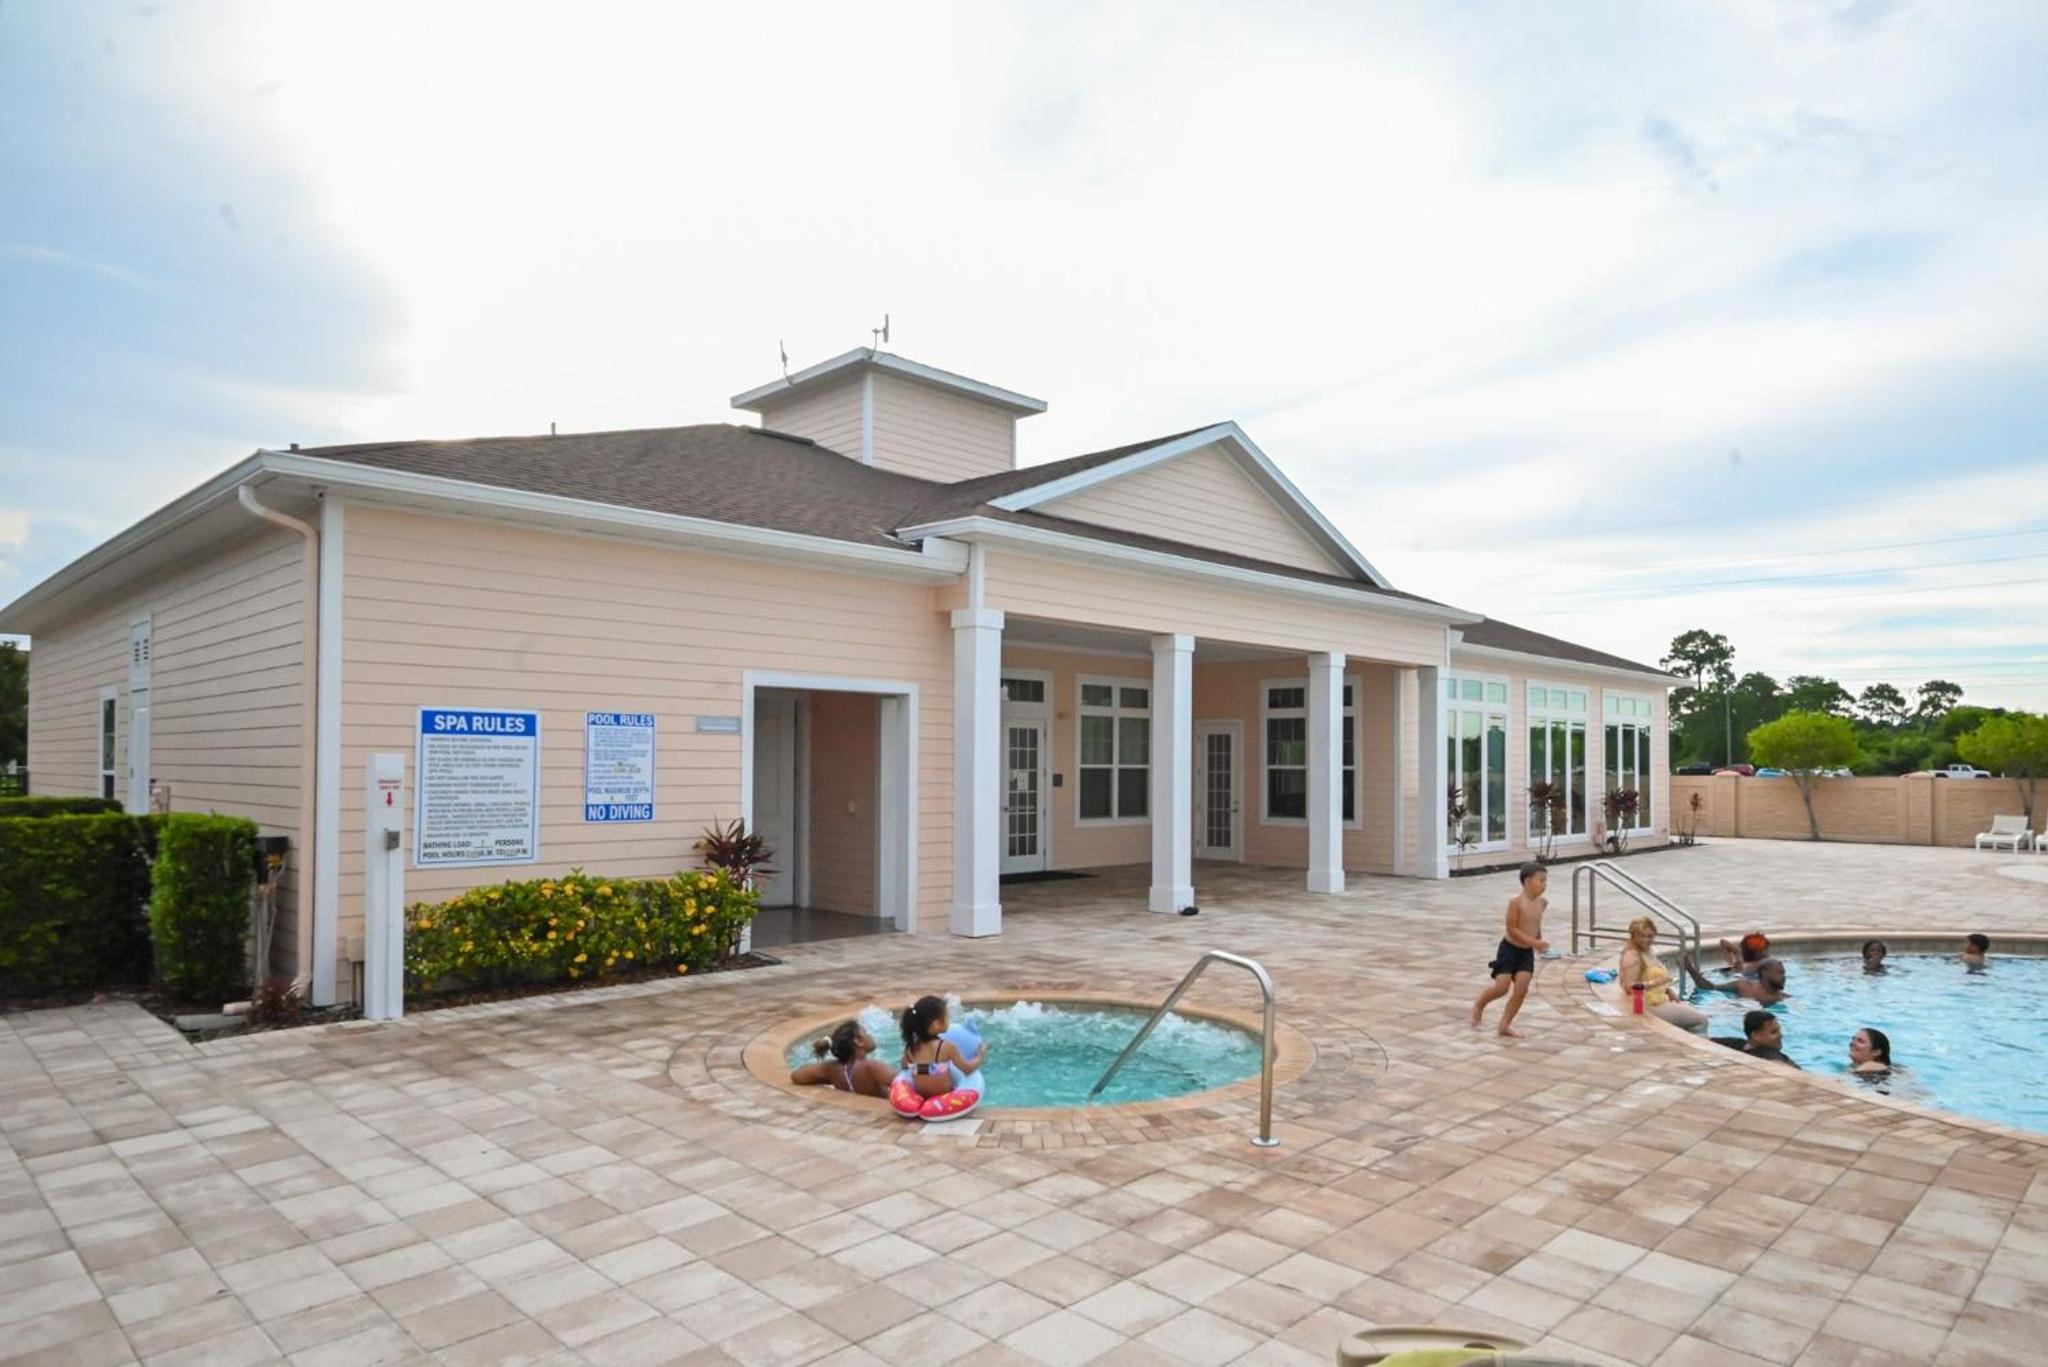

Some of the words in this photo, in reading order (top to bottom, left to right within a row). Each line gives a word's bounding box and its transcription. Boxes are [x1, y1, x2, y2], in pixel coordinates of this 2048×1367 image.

[433, 715, 469, 732] SPA
[472, 716, 526, 732] RULES
[588, 715, 618, 725] POOL
[619, 716, 653, 726] RULES
[588, 805, 606, 820] NO
[609, 805, 651, 819] DIVING
[423, 841, 452, 849] BATHING
[495, 838, 524, 846] PERSONS
